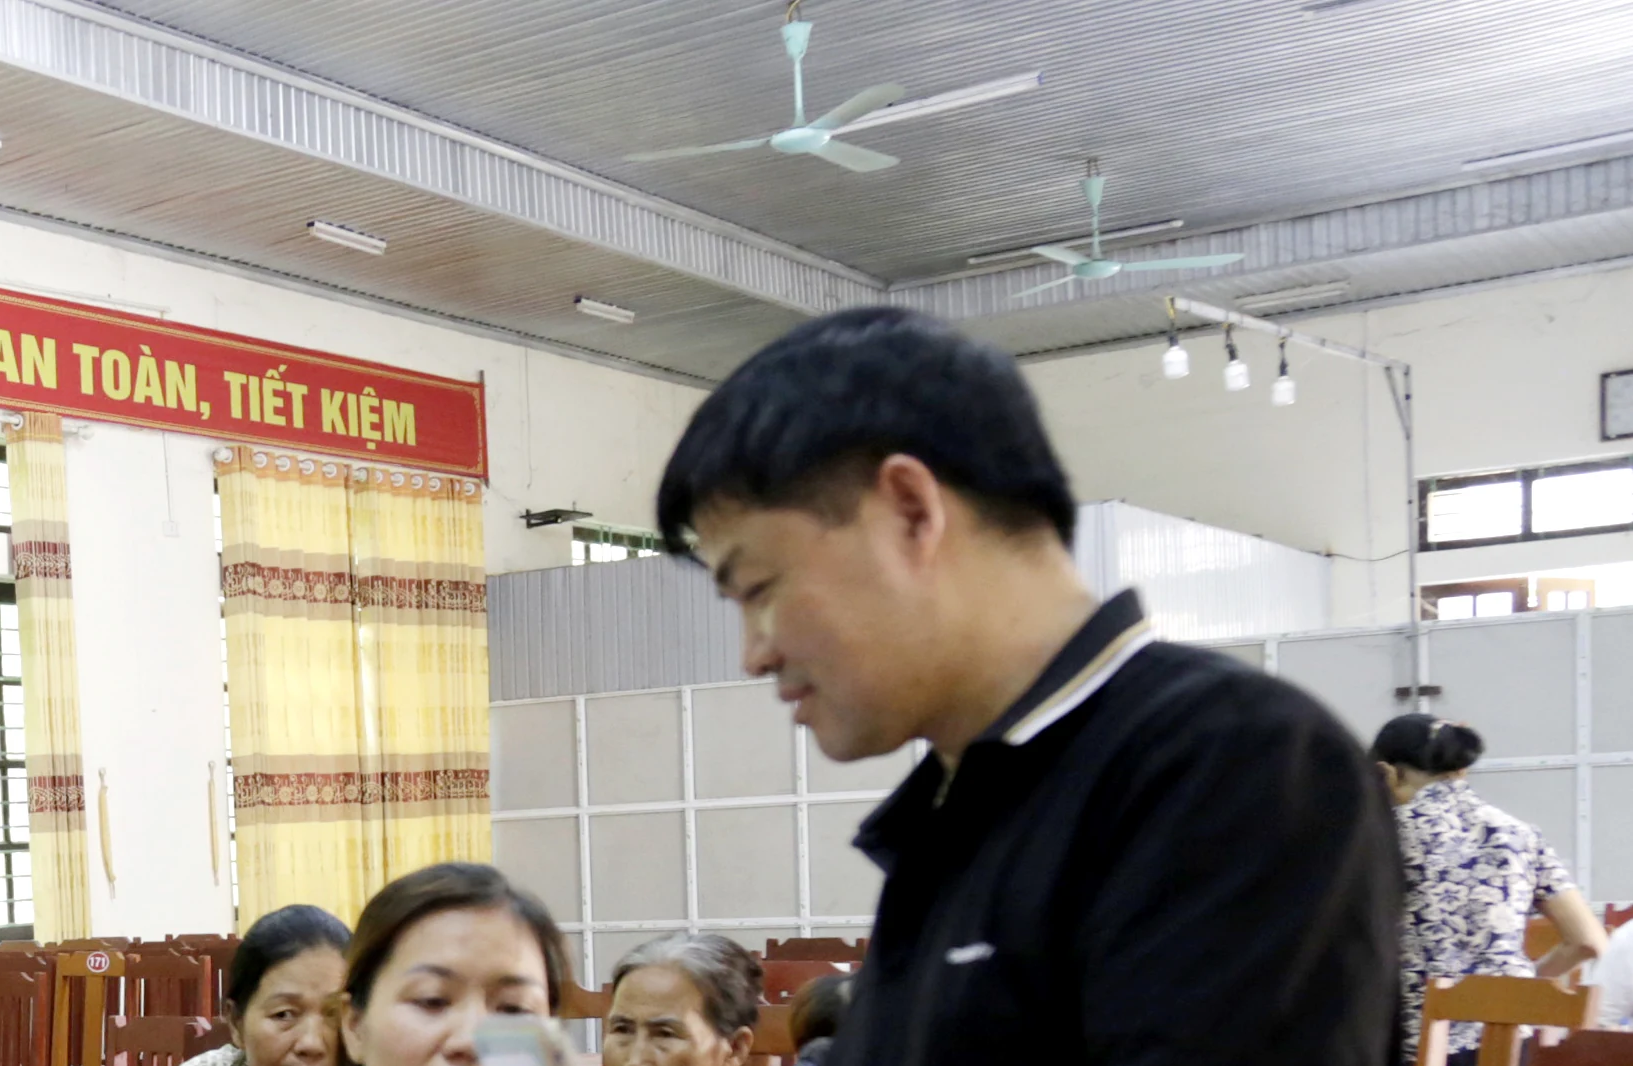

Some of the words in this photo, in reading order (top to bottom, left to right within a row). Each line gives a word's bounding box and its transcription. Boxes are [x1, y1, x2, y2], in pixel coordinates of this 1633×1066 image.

[73, 343, 211, 421] TOÀN,
[223, 364, 309, 429] TIẾT
[321, 386, 417, 450] KIỆM
[89, 956, 106, 968] 171
